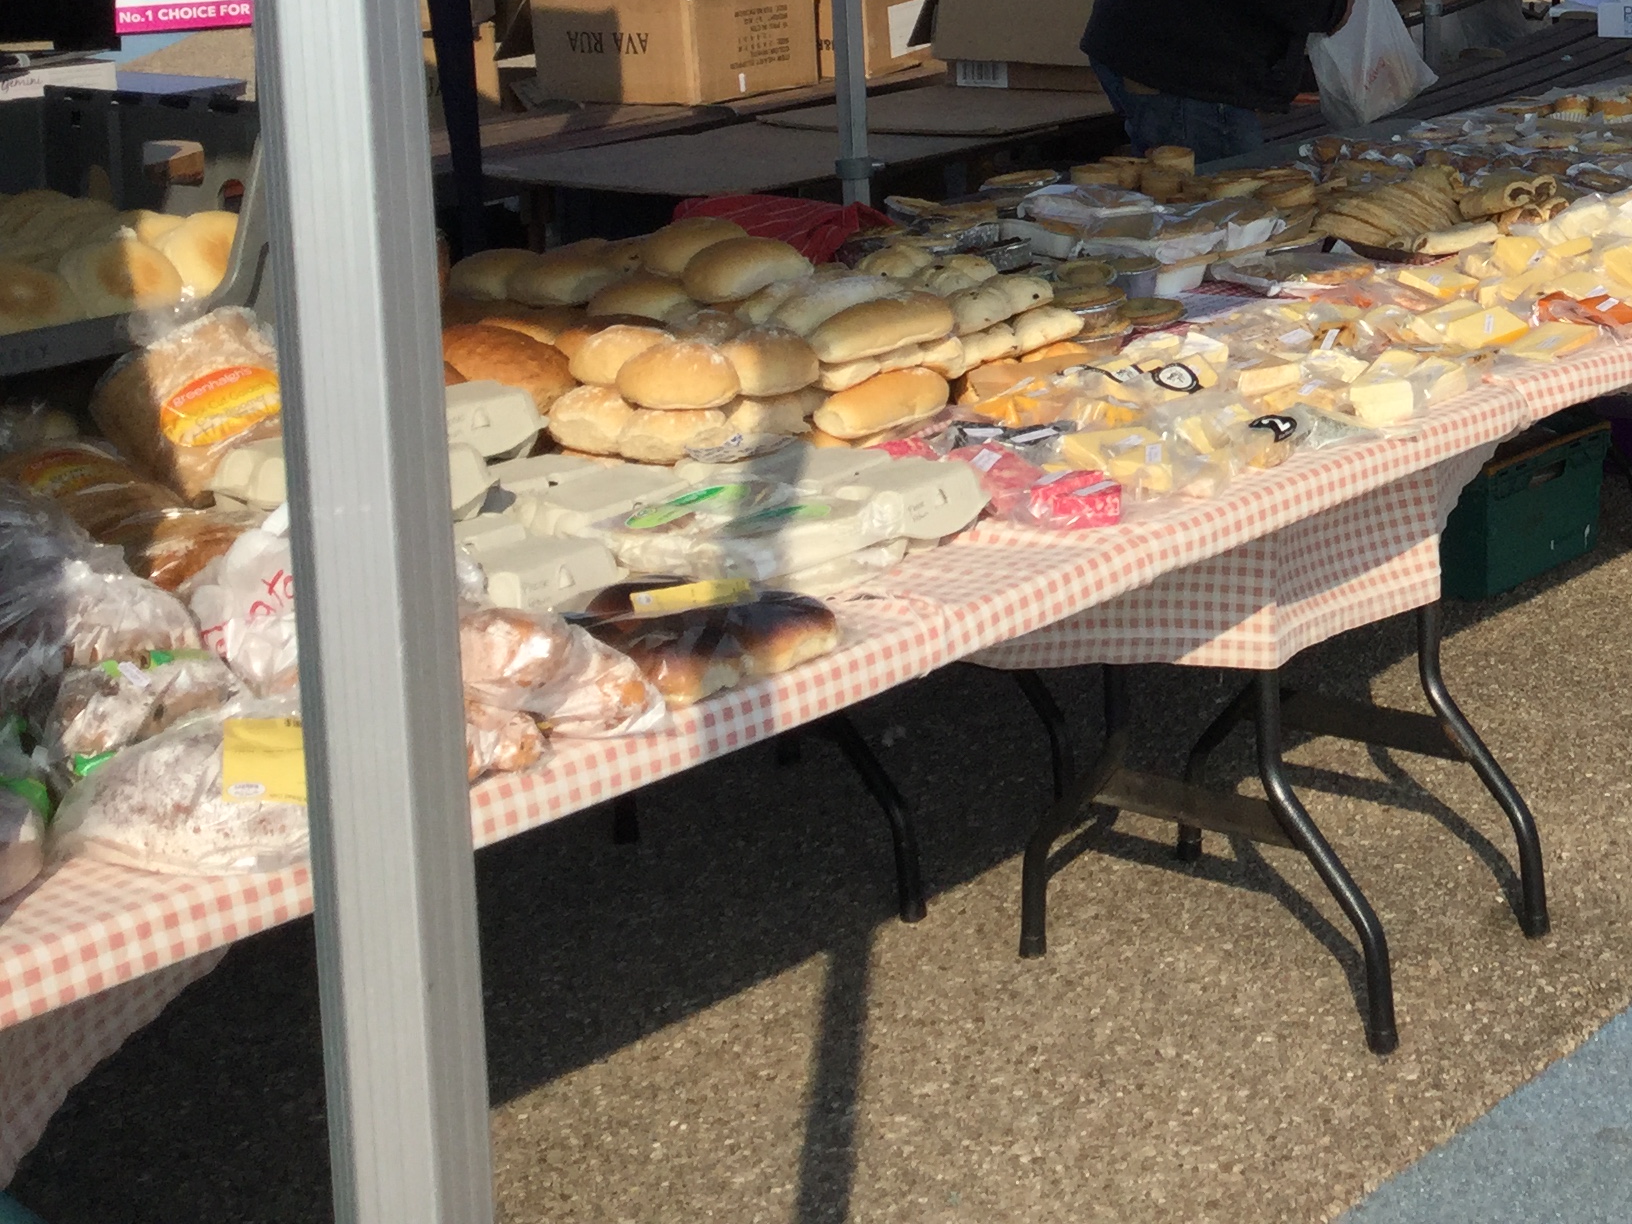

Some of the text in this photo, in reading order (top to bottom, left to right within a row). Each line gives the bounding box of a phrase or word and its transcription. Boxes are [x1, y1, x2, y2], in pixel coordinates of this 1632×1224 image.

[119, 3, 250, 24] No.1 CHOICE FOR
[566, 31, 649, 54] AVA RUA
